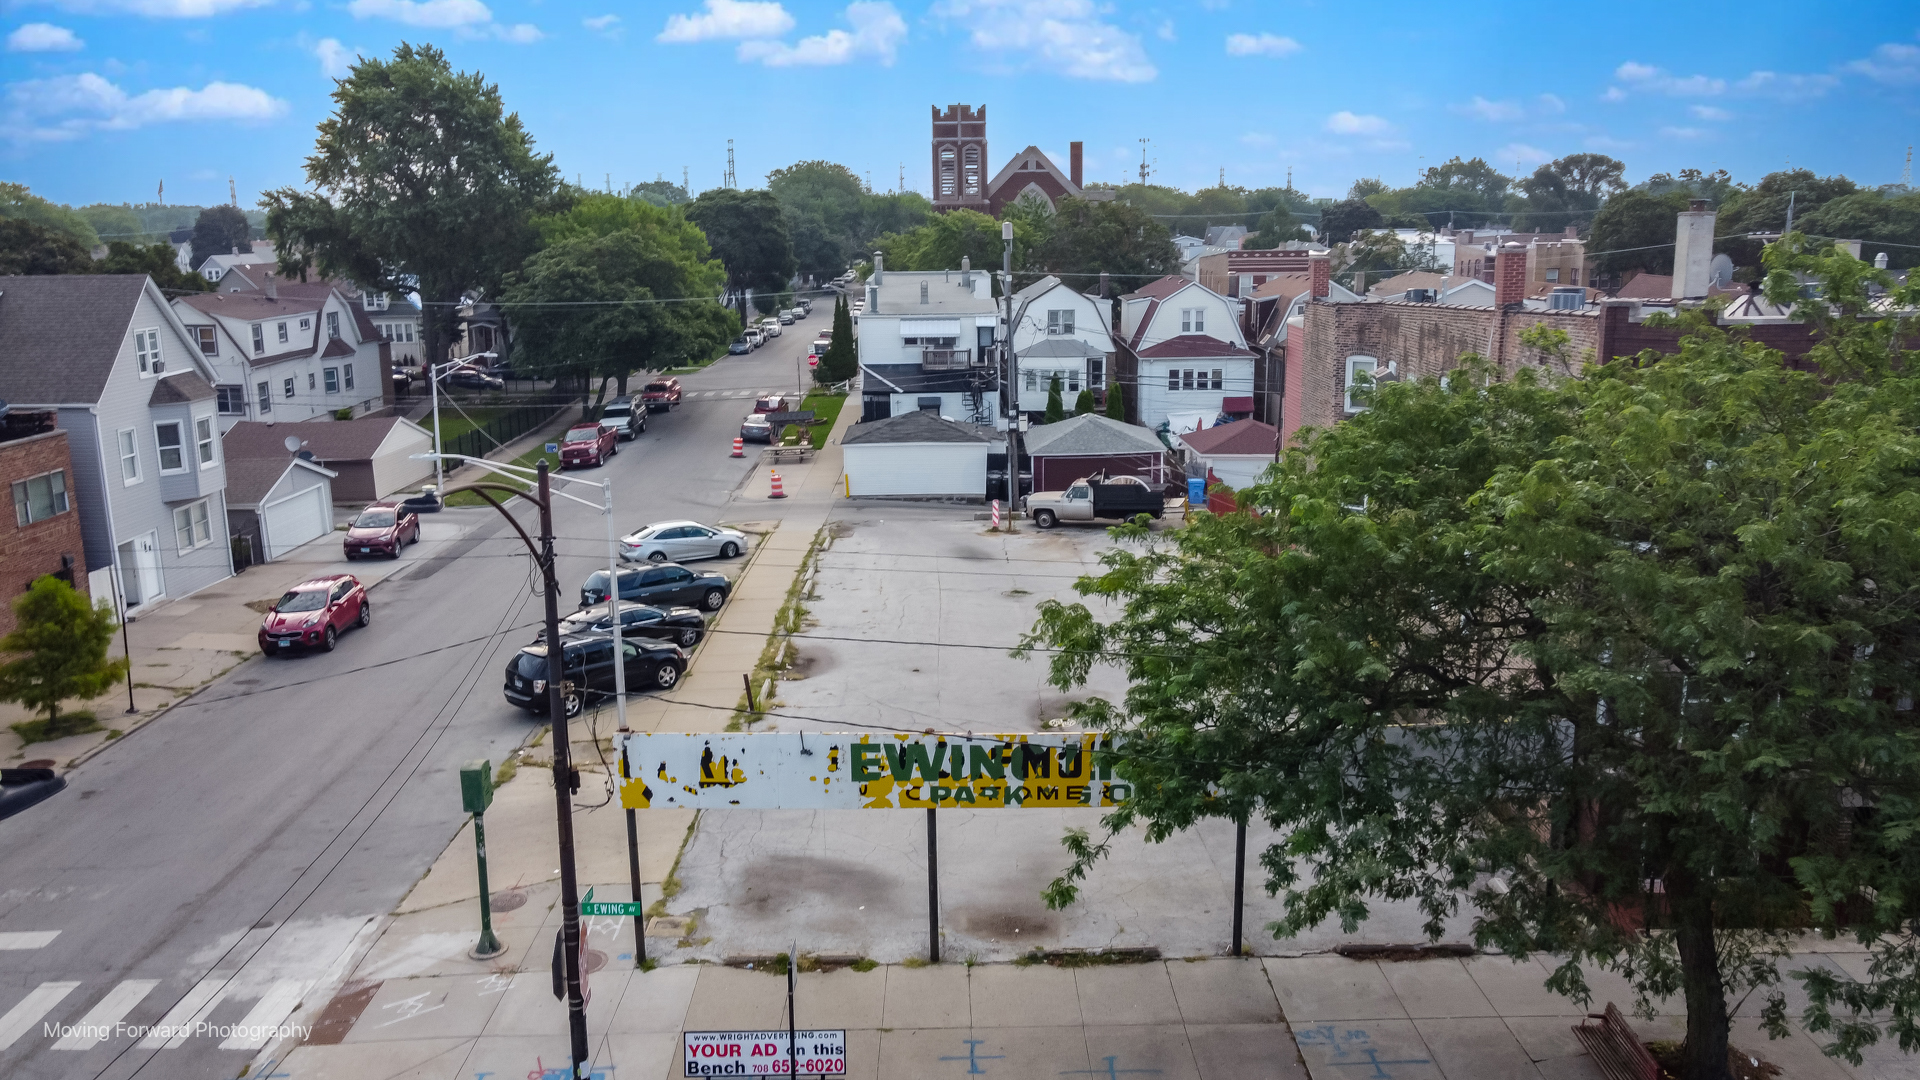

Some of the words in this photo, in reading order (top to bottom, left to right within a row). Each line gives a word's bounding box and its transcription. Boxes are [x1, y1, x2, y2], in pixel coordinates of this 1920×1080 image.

[593, 904, 624, 915] EWING
[628, 905, 636, 913] AV
[693, 1031, 838, 1042] www.WRIGHTADVERTSING.com
[688, 1043, 742, 1058] YOUR
[751, 1043, 778, 1057] AD
[813, 1043, 844, 1056] this
[687, 1060, 746, 1075] Bench
[752, 1064, 769, 1073] 708
